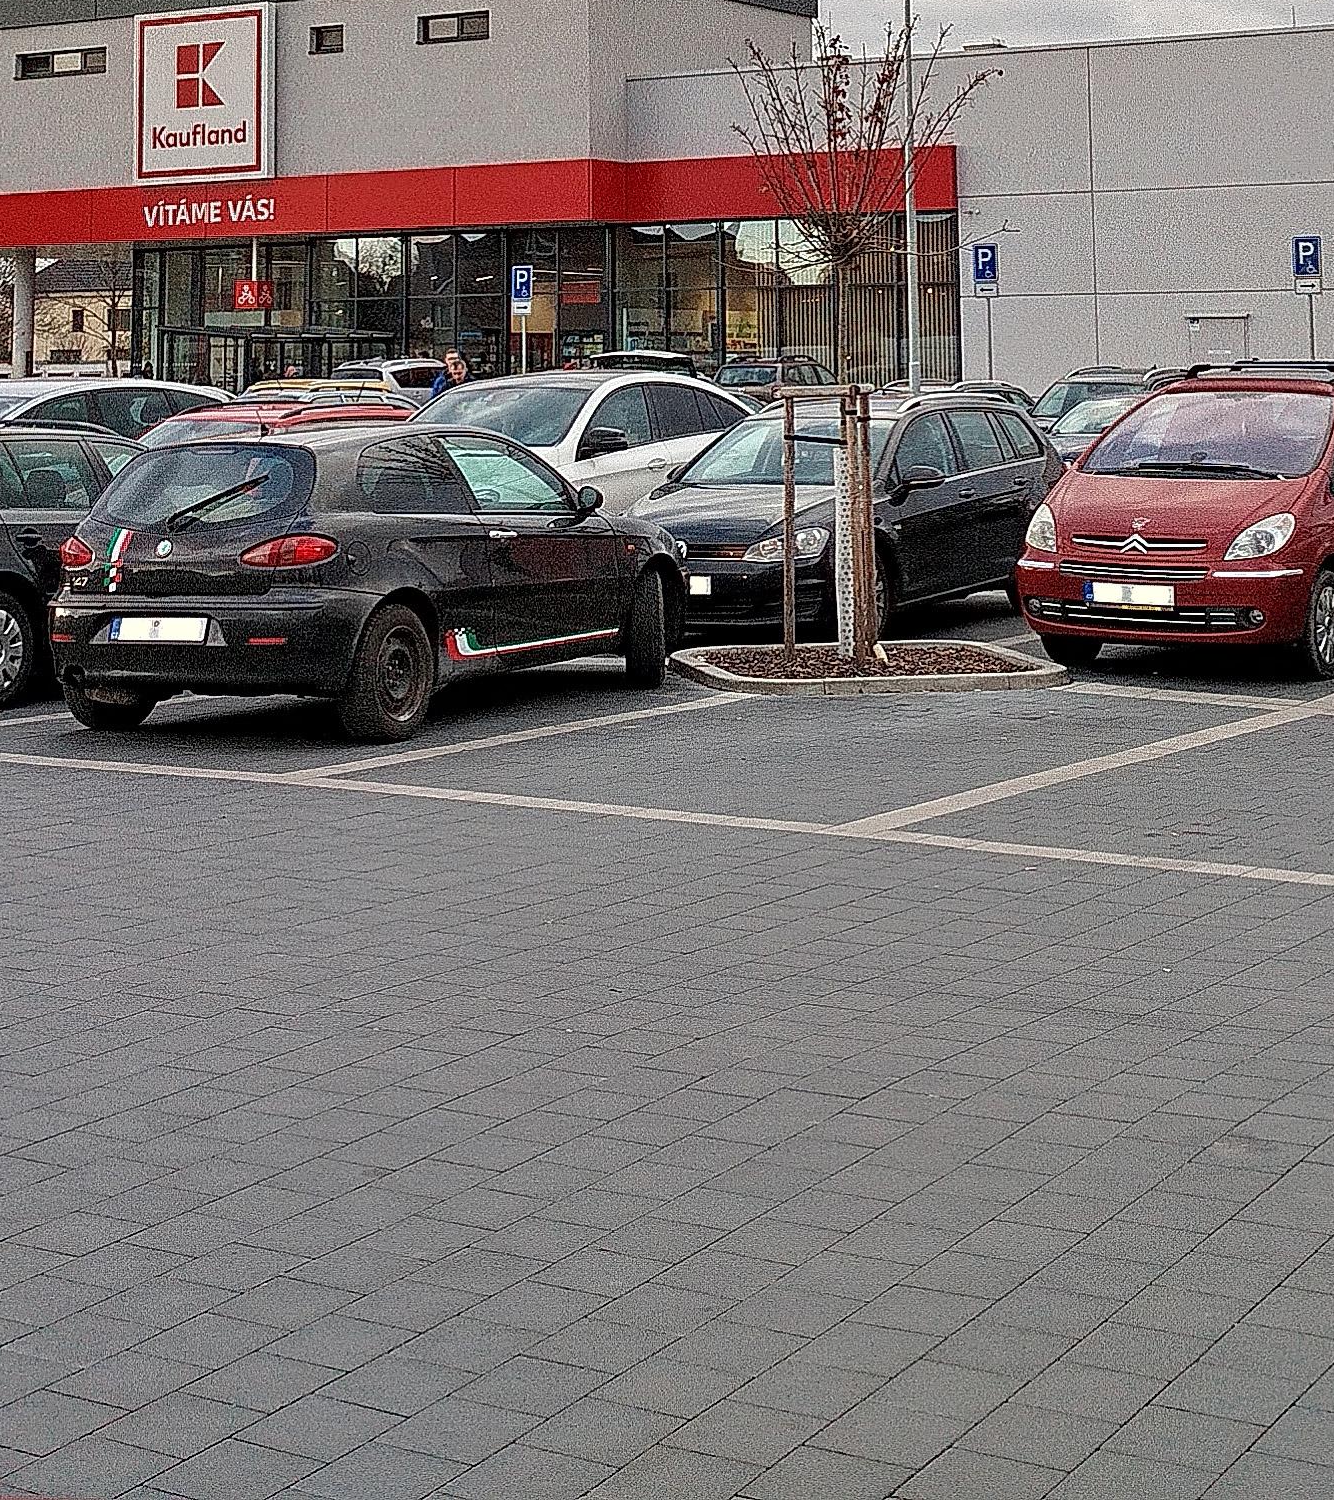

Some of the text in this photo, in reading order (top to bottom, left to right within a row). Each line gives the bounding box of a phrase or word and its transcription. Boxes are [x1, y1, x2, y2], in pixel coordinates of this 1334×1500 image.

[151, 119, 247, 149] Kaufland
[143, 194, 275, 228] VÍTÁME VÁS!
[977, 248, 993, 270] P
[1298, 241, 1315, 265] P
[516, 269, 528, 290] P
